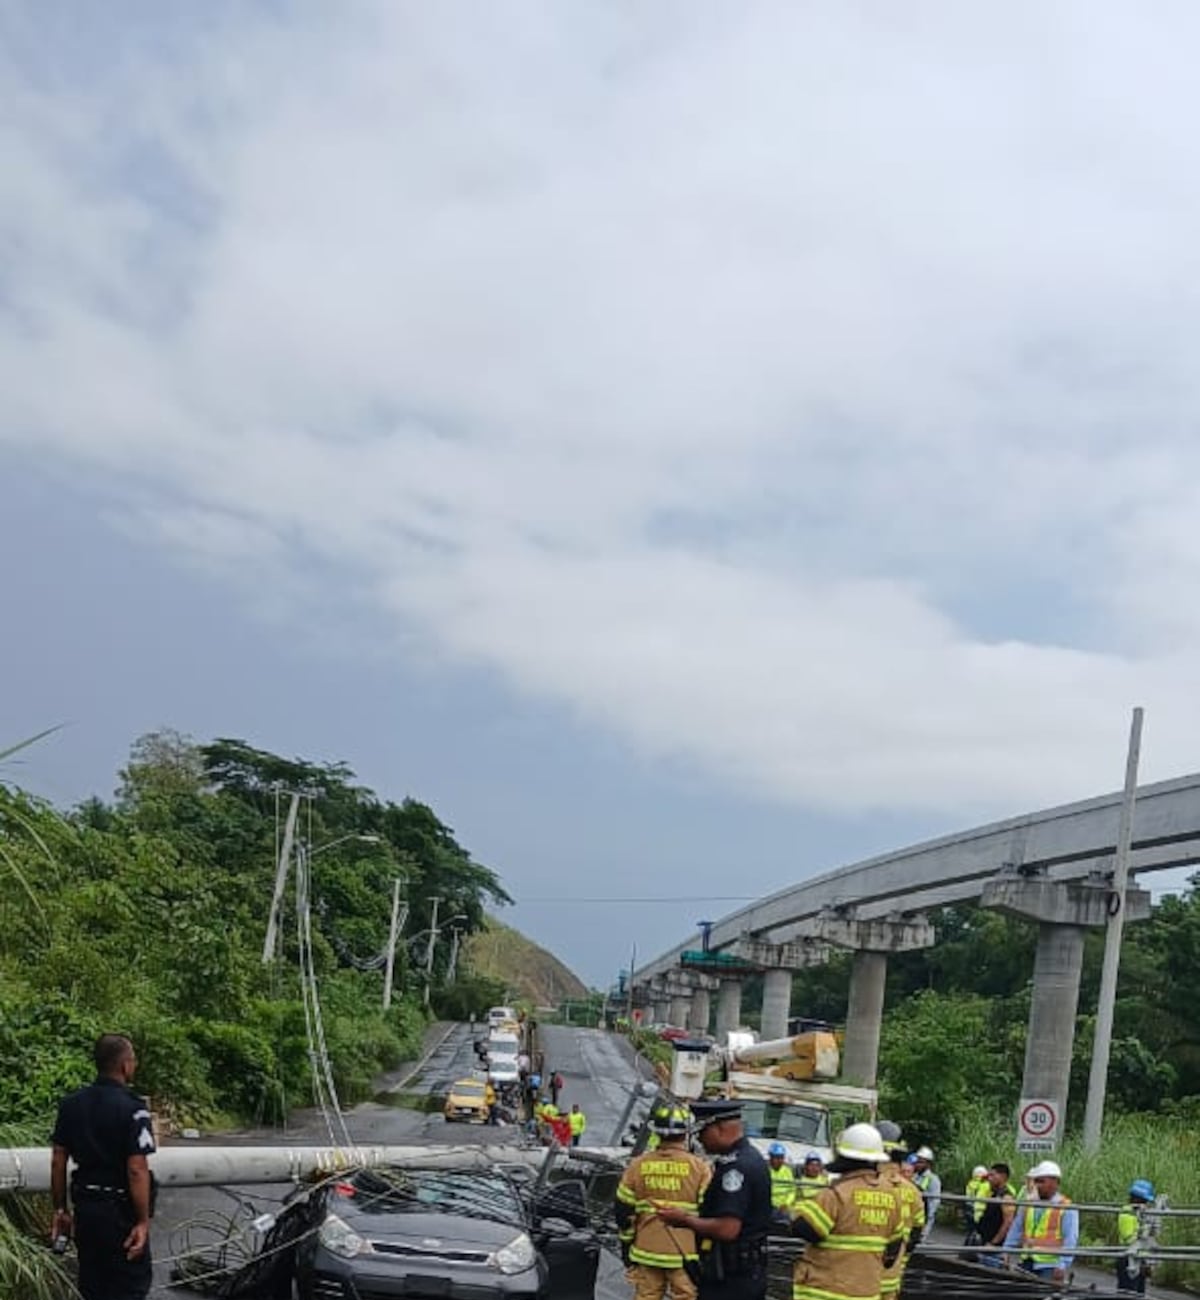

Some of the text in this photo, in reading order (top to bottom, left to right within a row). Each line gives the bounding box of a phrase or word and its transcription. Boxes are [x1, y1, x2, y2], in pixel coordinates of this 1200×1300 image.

[1030, 1112, 1046, 1123] 30
[640, 1161, 690, 1176] BOMBEROS
[854, 1190, 896, 1208] BOMBEROS
